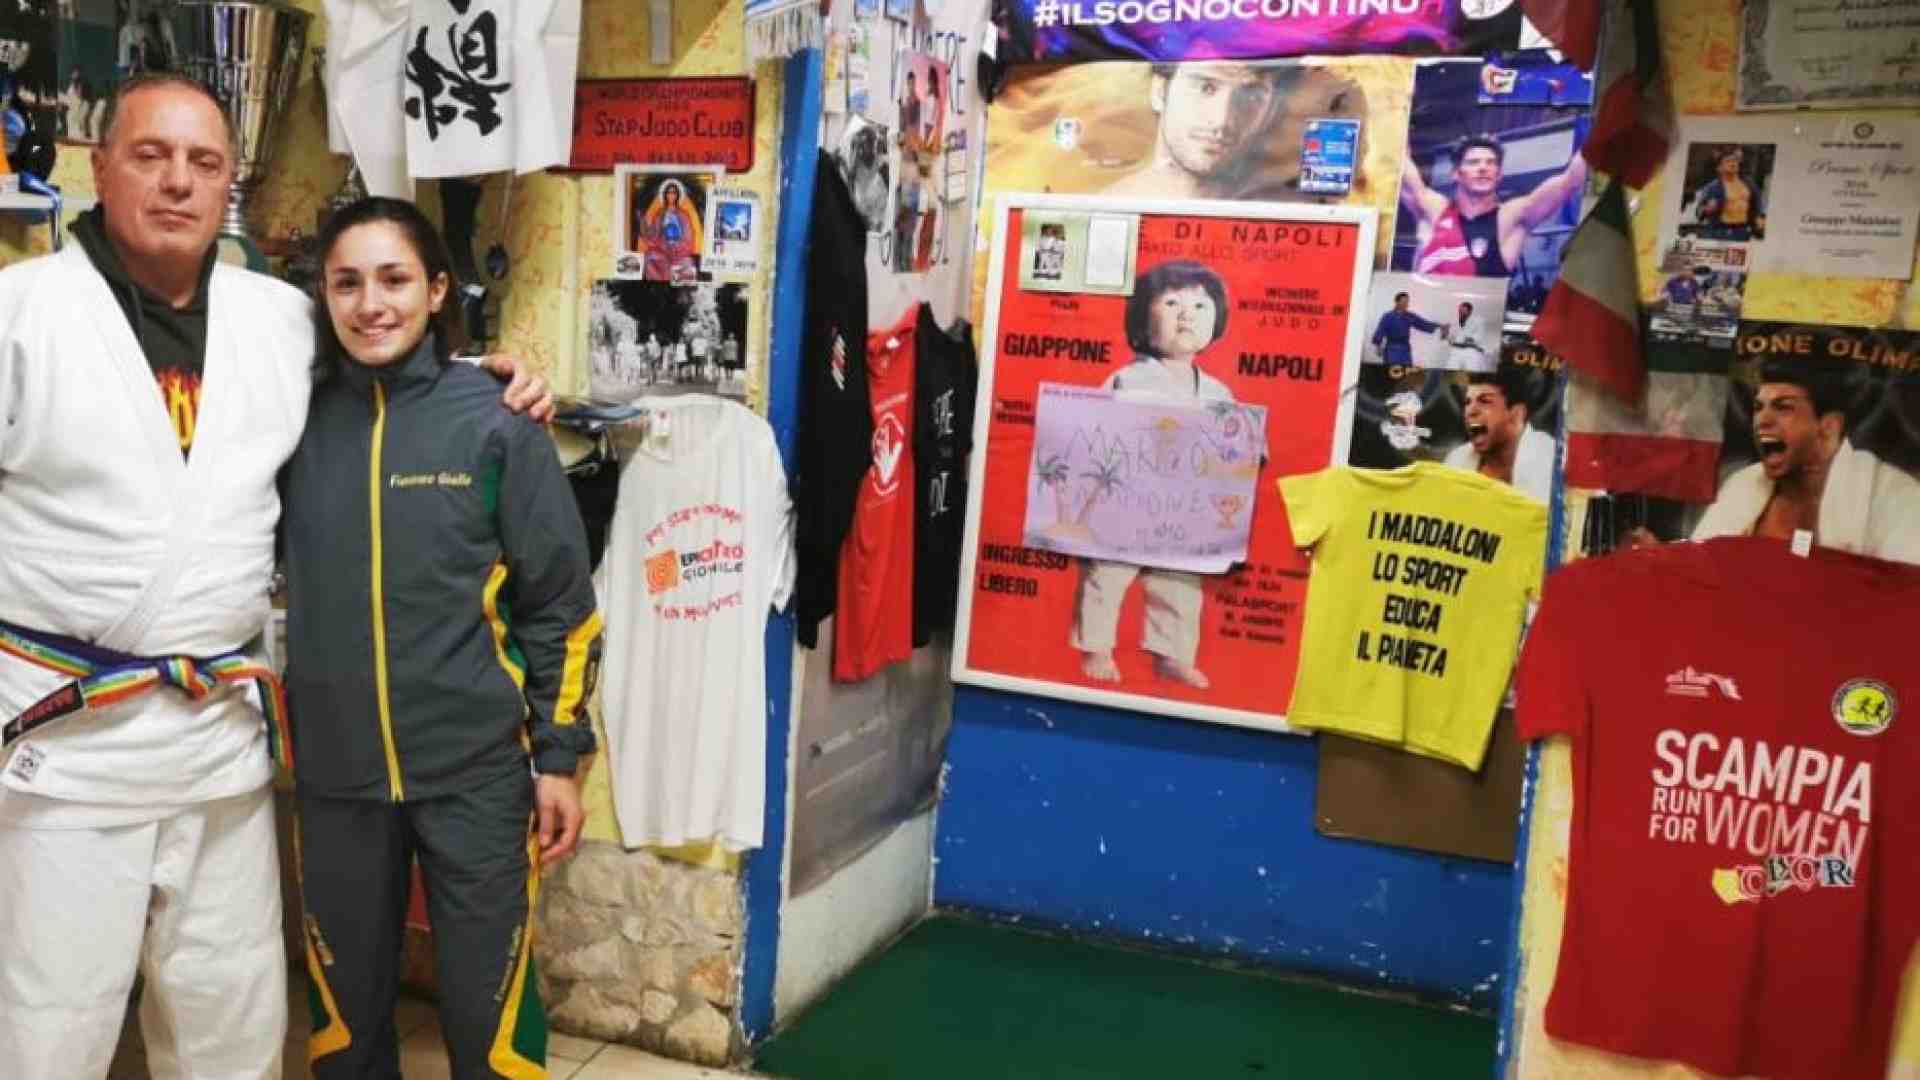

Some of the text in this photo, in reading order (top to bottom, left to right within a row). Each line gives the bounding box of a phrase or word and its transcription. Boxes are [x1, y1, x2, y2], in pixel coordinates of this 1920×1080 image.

[640, 110, 690, 137] JUDO
[693, 111, 744, 139] CLUB
[1174, 222, 1343, 248] DI NAPOLI
[1003, 333, 1112, 364] GIAPPONE
[1237, 351, 1325, 382] NAPOLI
[1367, 510, 1501, 564] I MADDALONI
[983, 544, 1069, 571] INGRESSO
[979, 574, 1038, 598] LIBERO
[1372, 551, 1468, 597] LO SPORT
[1381, 594, 1443, 635] EDUCA
[1356, 630, 1371, 662] IL
[1652, 729, 1872, 824] SCAMPIA
[1652, 787, 1702, 816] RUN
[1649, 792, 1869, 880] FOR WOMEN
